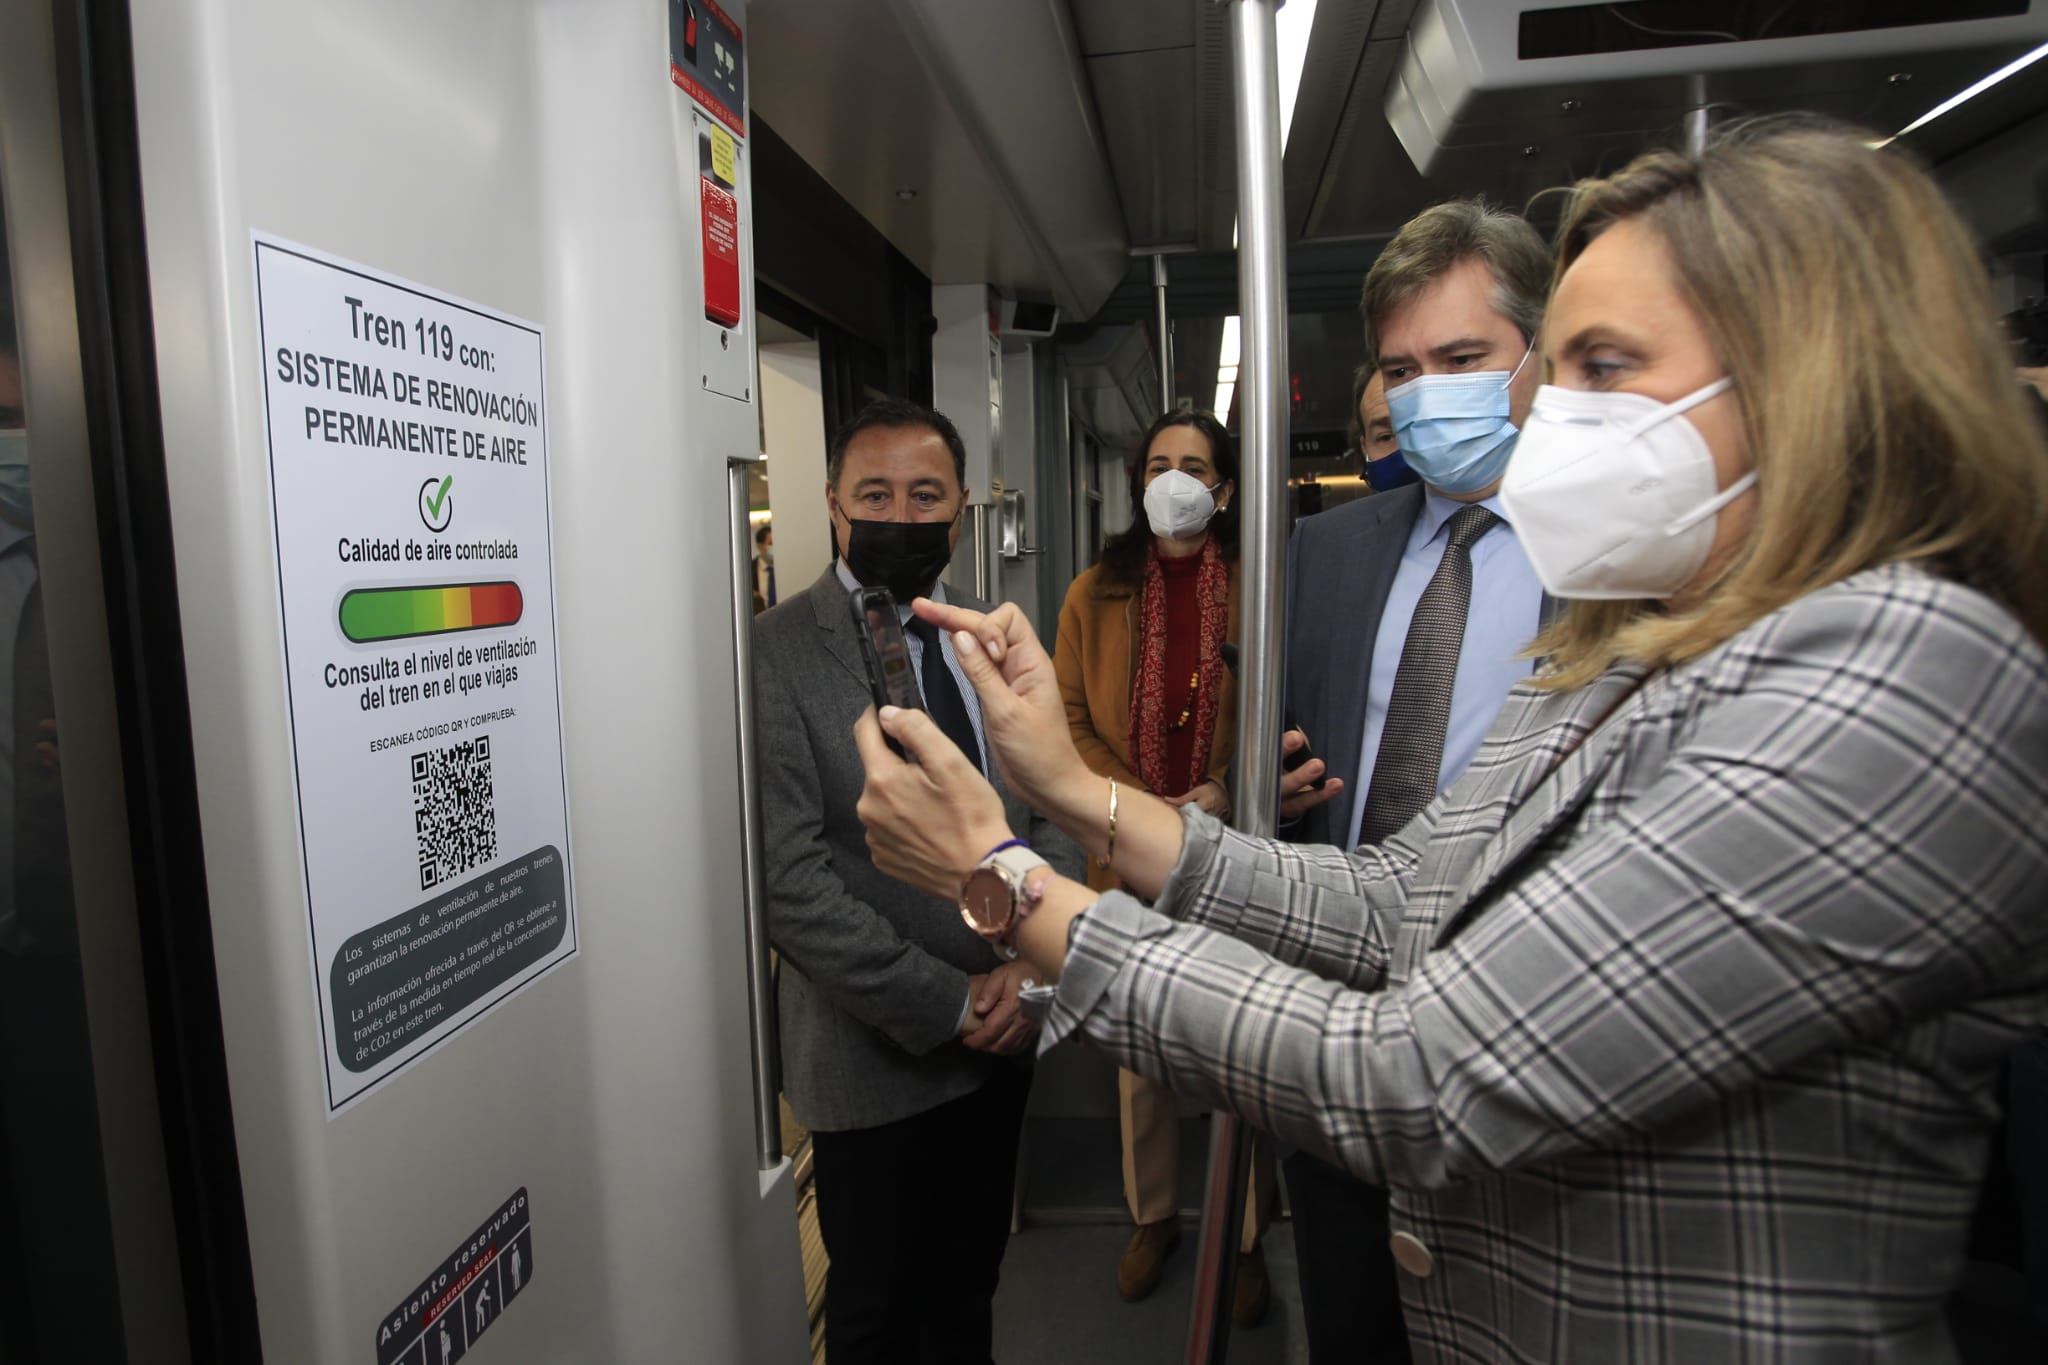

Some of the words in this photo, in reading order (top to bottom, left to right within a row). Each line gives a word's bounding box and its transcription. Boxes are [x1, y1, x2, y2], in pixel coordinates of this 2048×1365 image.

[344, 295, 406, 350] Tren
[415, 317, 453, 362] 119
[459, 343, 496, 373] con:
[277, 347, 389, 400] SISTEMA
[393, 371, 422, 406] DE
[427, 379, 538, 427] RENOVACIÓN
[305, 406, 459, 457] PERMANENTE
[463, 430, 487, 461] DE
[490, 435, 528, 466] AIRE
[338, 537, 400, 562] Calidad
[405, 538, 422, 561] de
[426, 539, 452, 561] aire
[455, 539, 518, 560] controlada
[324, 656, 400, 689] Consulta
[404, 652, 417, 676] el
[421, 647, 453, 673] nivel
[457, 645, 473, 667] de
[475, 636, 537, 663] ventilación
[360, 686, 385, 712] del
[389, 683, 419, 706] tren
[423, 679, 440, 698] en
[444, 673, 455, 694] el
[459, 672, 482, 696] que
[485, 665, 518, 689] viajas
[370, 732, 415, 753] ESCANEA
[416, 723, 450, 741] CÓDIGO
[451, 721, 463, 733] QR
[464, 719, 470, 729] Y
[470, 707, 517, 727] COMPRUEBA:
[345, 947, 363, 963] Los
[372, 924, 411, 950] sistemas
[419, 914, 430, 926] de
[437, 889, 479, 918] ventilación
[485, 881, 495, 893] de
[500, 866, 529, 886] nuestros
[533, 853, 553, 870] trenes
[347, 951, 398, 985] garantizan
[400, 943, 408, 957] la
[409, 922, 454, 951] renovación
[455, 898, 499, 930] permanente
[499, 891, 509, 904] de
[509, 885, 524, 901] aire.
[351, 1010, 364, 1022] La
[367, 976, 422, 1014] información
[425, 957, 457, 981] ofrecida
[459, 952, 465, 961] a
[467, 938, 489, 957] través
[491, 930, 502, 945] del
[504, 921, 515, 935] QR
[516, 916, 525, 927] se
[526, 902, 551, 922] obtiene
[551, 900, 557, 910] a
[353, 1018, 383, 1042] través
[385, 1009, 398, 1022] de
[400, 1002, 408, 1016] la
[409, 983, 441, 1010] medida
[442, 976, 453, 989] en
[454, 960, 481, 983] tiempo
[482, 951, 496, 969] real
[496, 945, 506, 957] de
[506, 937, 513, 950] la
[355, 1047, 369, 1062] de
[370, 1033, 391, 1052] CO2
[392, 1026, 404, 1040] en
[406, 1014, 424, 1032] este
[425, 1001, 445, 1023] tren.
[380, 1273, 447, 1346] Asiento
[454, 1196, 525, 1273] reservado
[430, 1272, 472, 1318] RESERVED
[474, 1250, 493, 1274] SEAT
